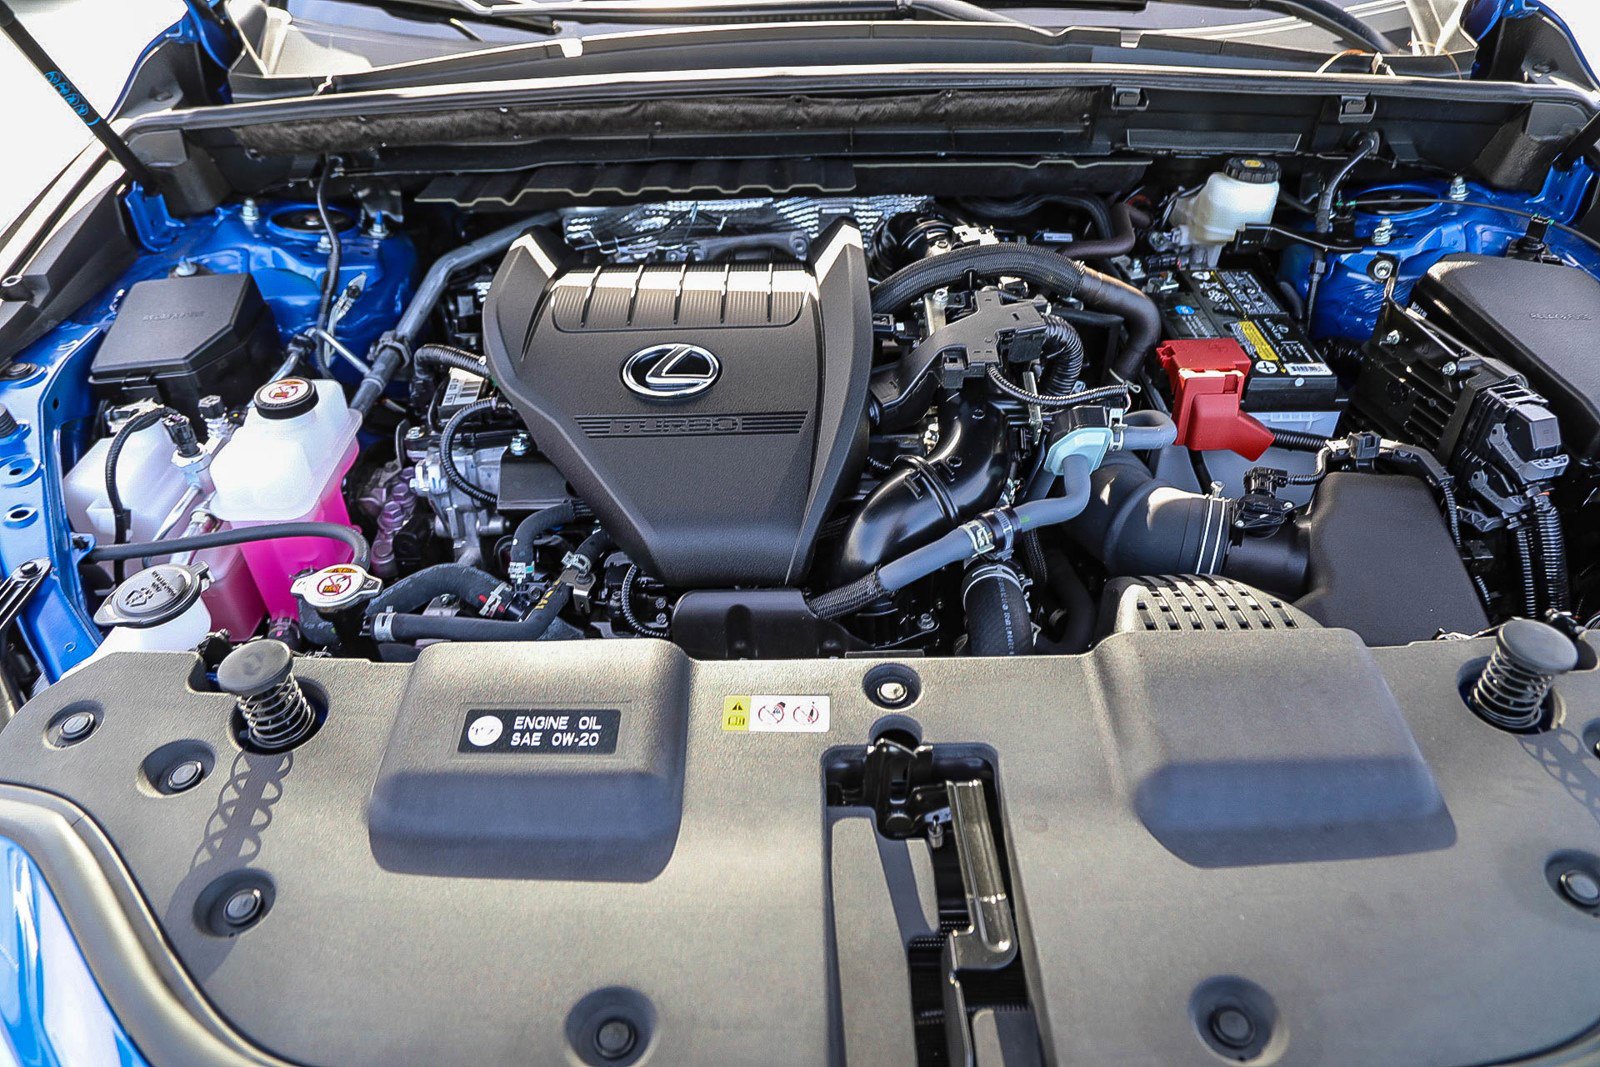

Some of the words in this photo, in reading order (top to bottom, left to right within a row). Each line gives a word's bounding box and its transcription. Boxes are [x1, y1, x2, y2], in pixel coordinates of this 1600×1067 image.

[613, 416, 739, 434] TURBO
[513, 715, 570, 730] ENGINE
[578, 715, 602, 730] OIL
[510, 732, 543, 746] SAE
[551, 732, 600, 746] 0W-20
